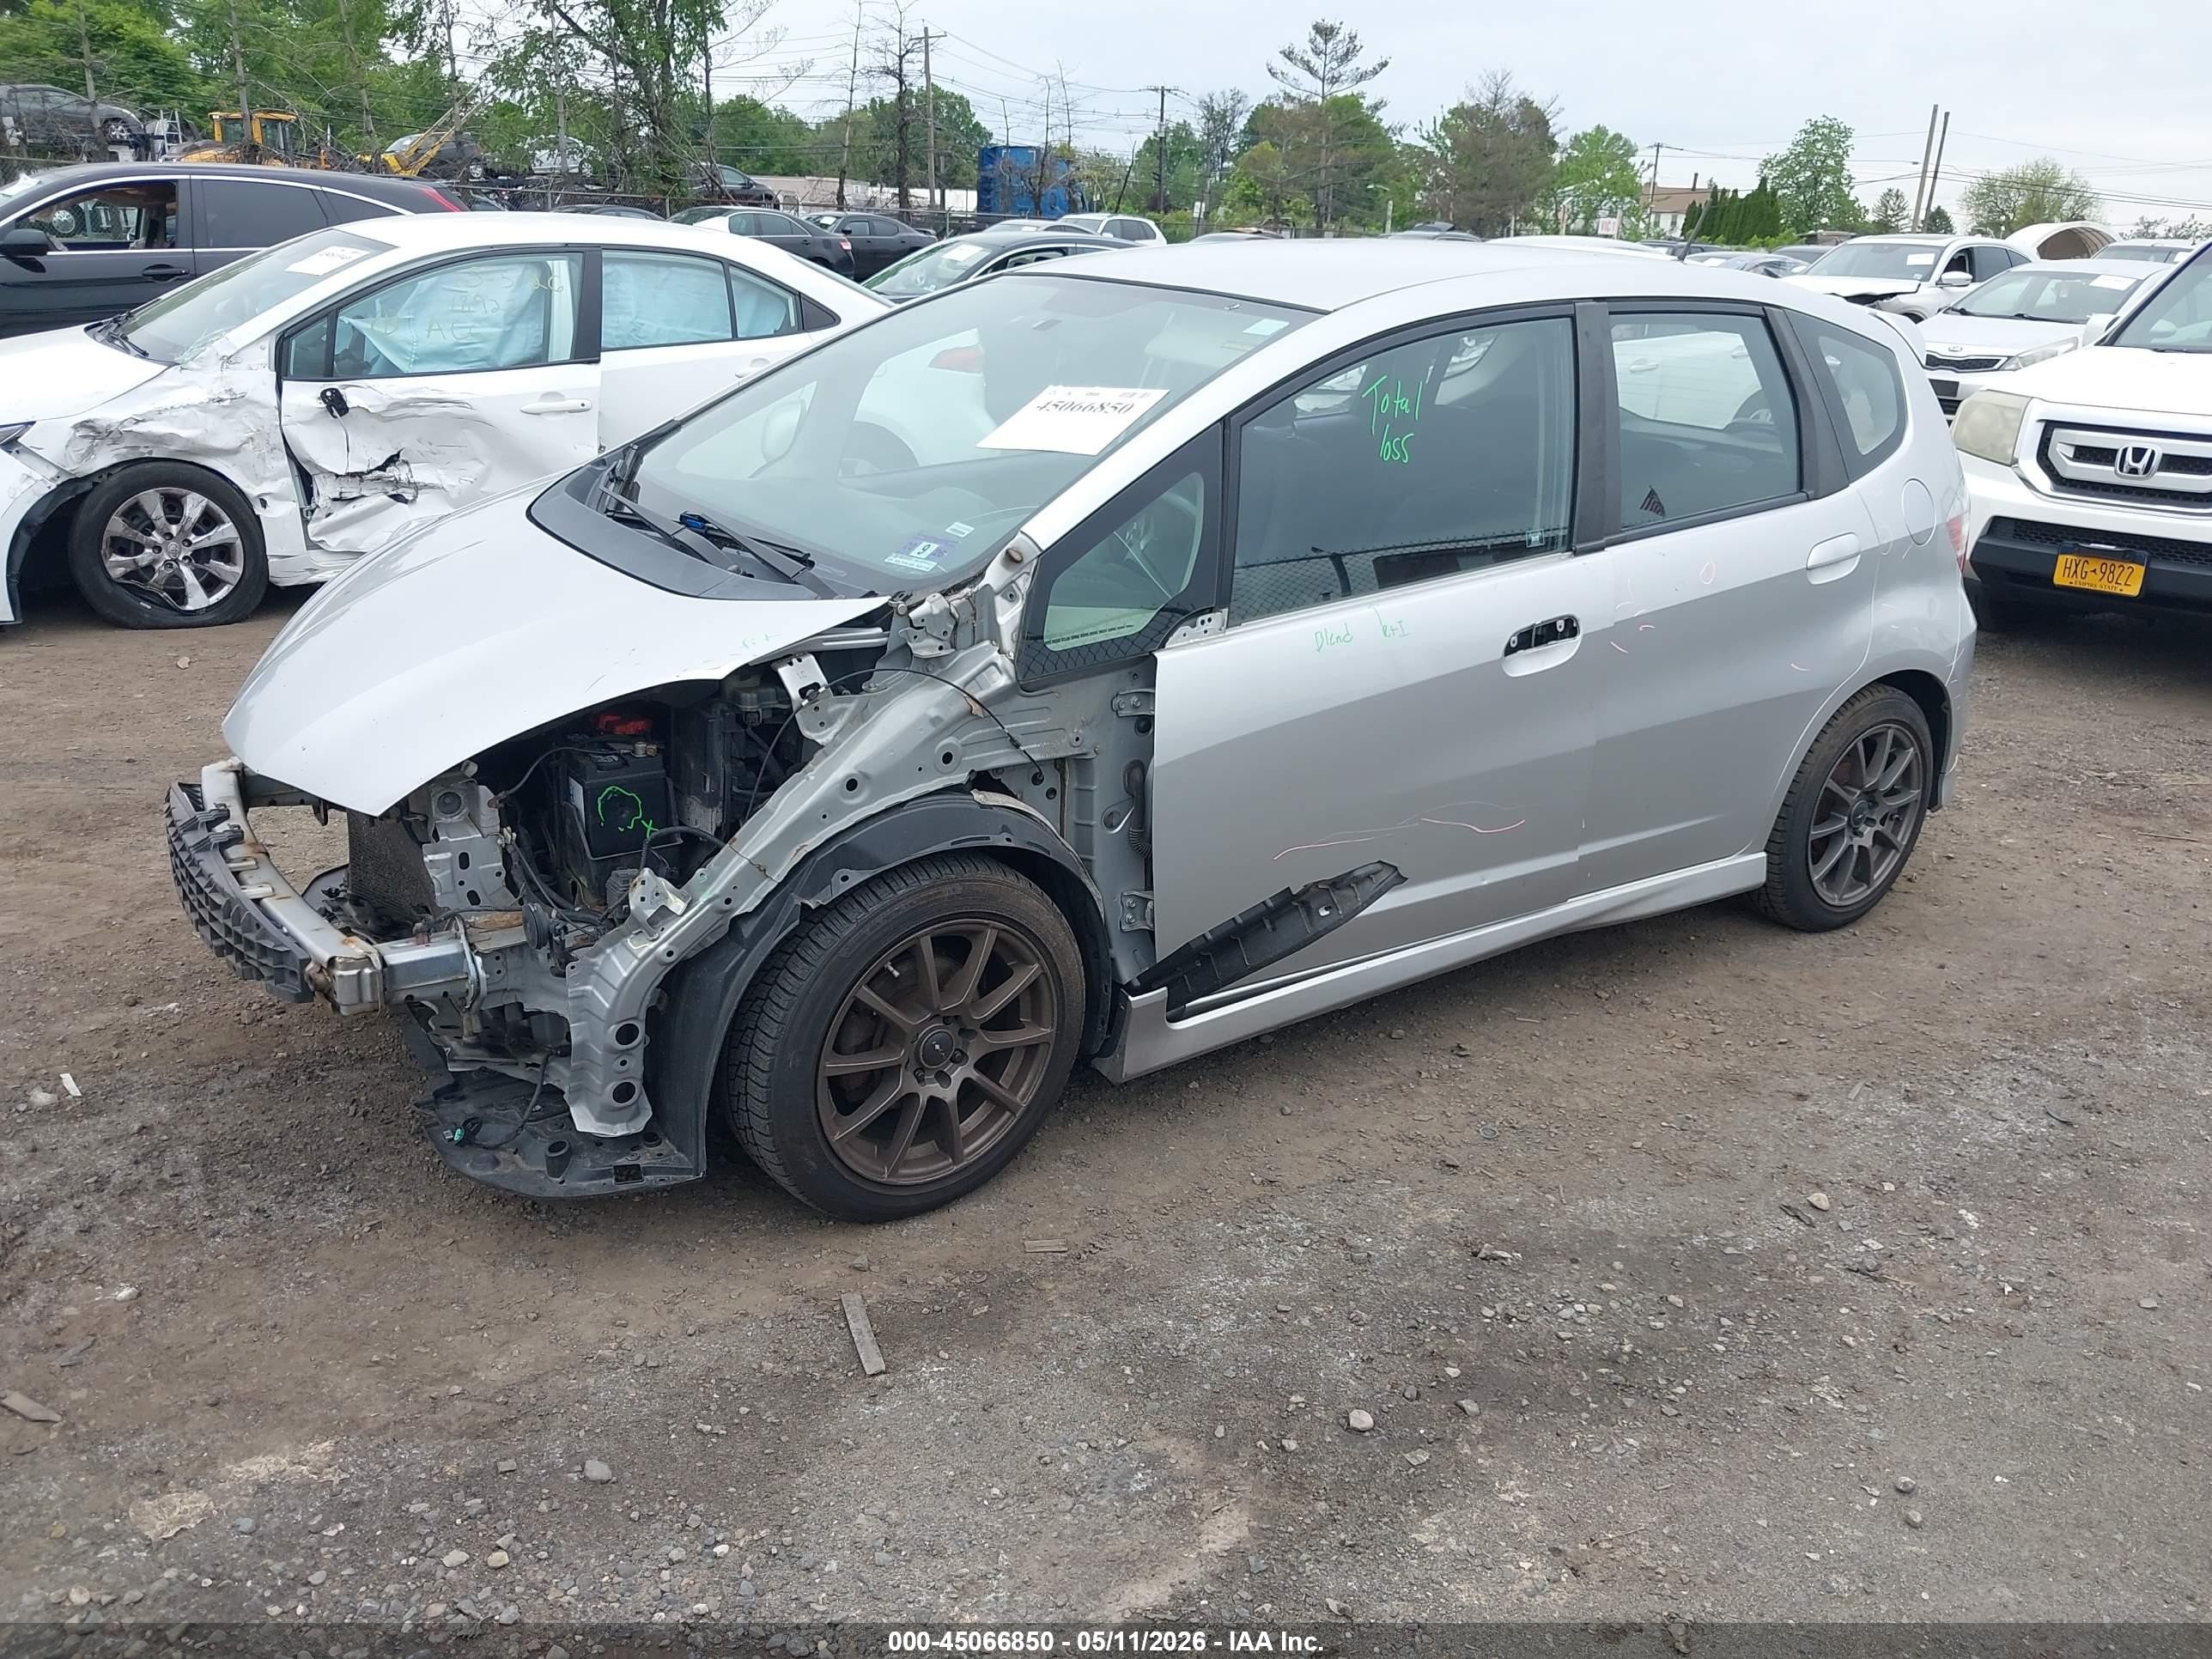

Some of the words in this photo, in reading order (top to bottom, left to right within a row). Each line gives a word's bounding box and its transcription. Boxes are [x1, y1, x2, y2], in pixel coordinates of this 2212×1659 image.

[1036, 400, 1135, 415] 45066850
[1362, 375, 1423, 436] Total
[1380, 423, 1414, 464] loss
[917, 544, 932, 556] 9
[2099, 562, 2135, 587] 9822
